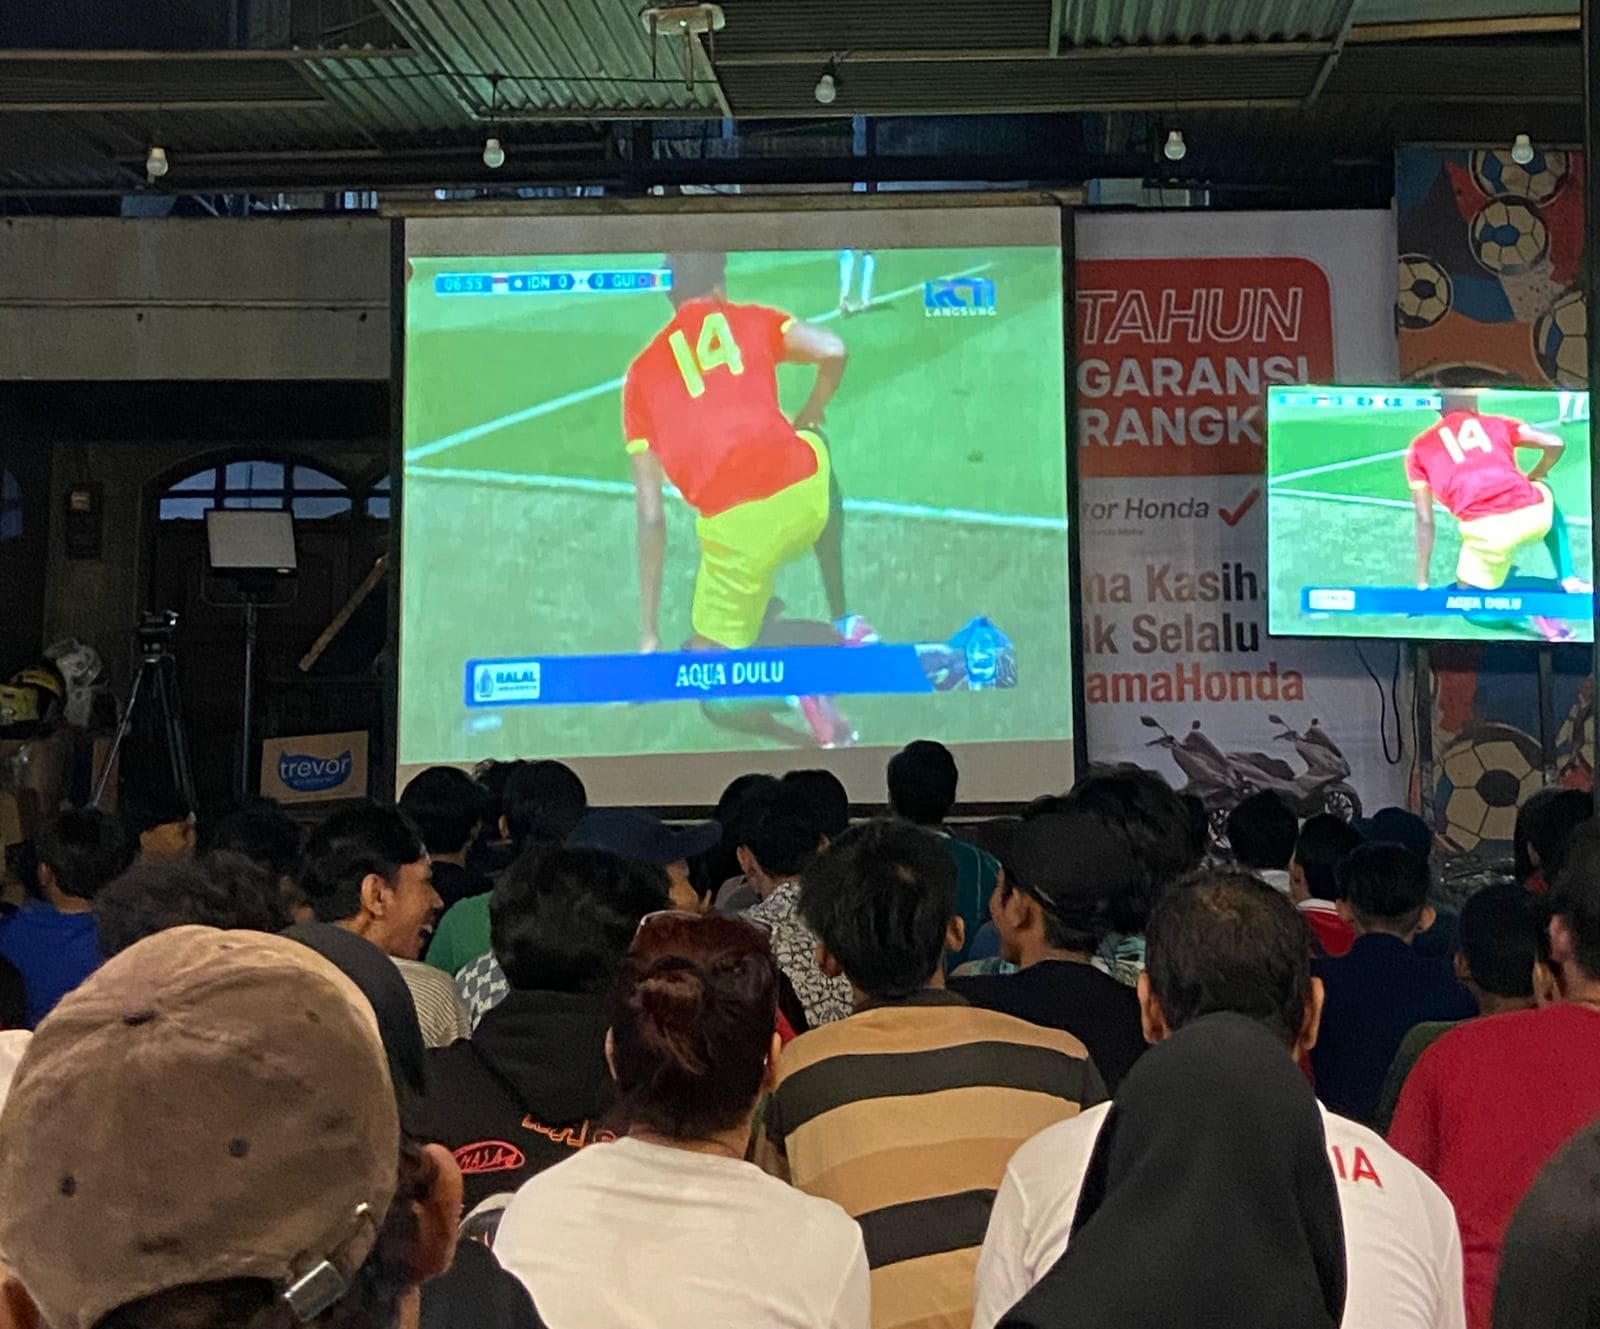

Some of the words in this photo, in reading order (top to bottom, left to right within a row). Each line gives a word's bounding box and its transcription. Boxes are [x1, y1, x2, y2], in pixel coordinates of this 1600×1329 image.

[527, 275, 550, 290] IDN
[558, 274, 568, 289] 0
[595, 273, 604, 288] 0
[612, 273, 636, 287] GUI
[924, 306, 997, 318] LANGSUNG
[1076, 287, 1303, 345] TAHUN
[668, 312, 745, 399] 14
[1076, 356, 1309, 397] GARANSI
[1437, 417, 1493, 464] 14
[1124, 497, 1210, 520] Honda
[1132, 612, 1260, 655] Selalu
[675, 662, 727, 691] AQUA
[732, 660, 785, 685] DULU
[280, 757, 350, 780] trevor
